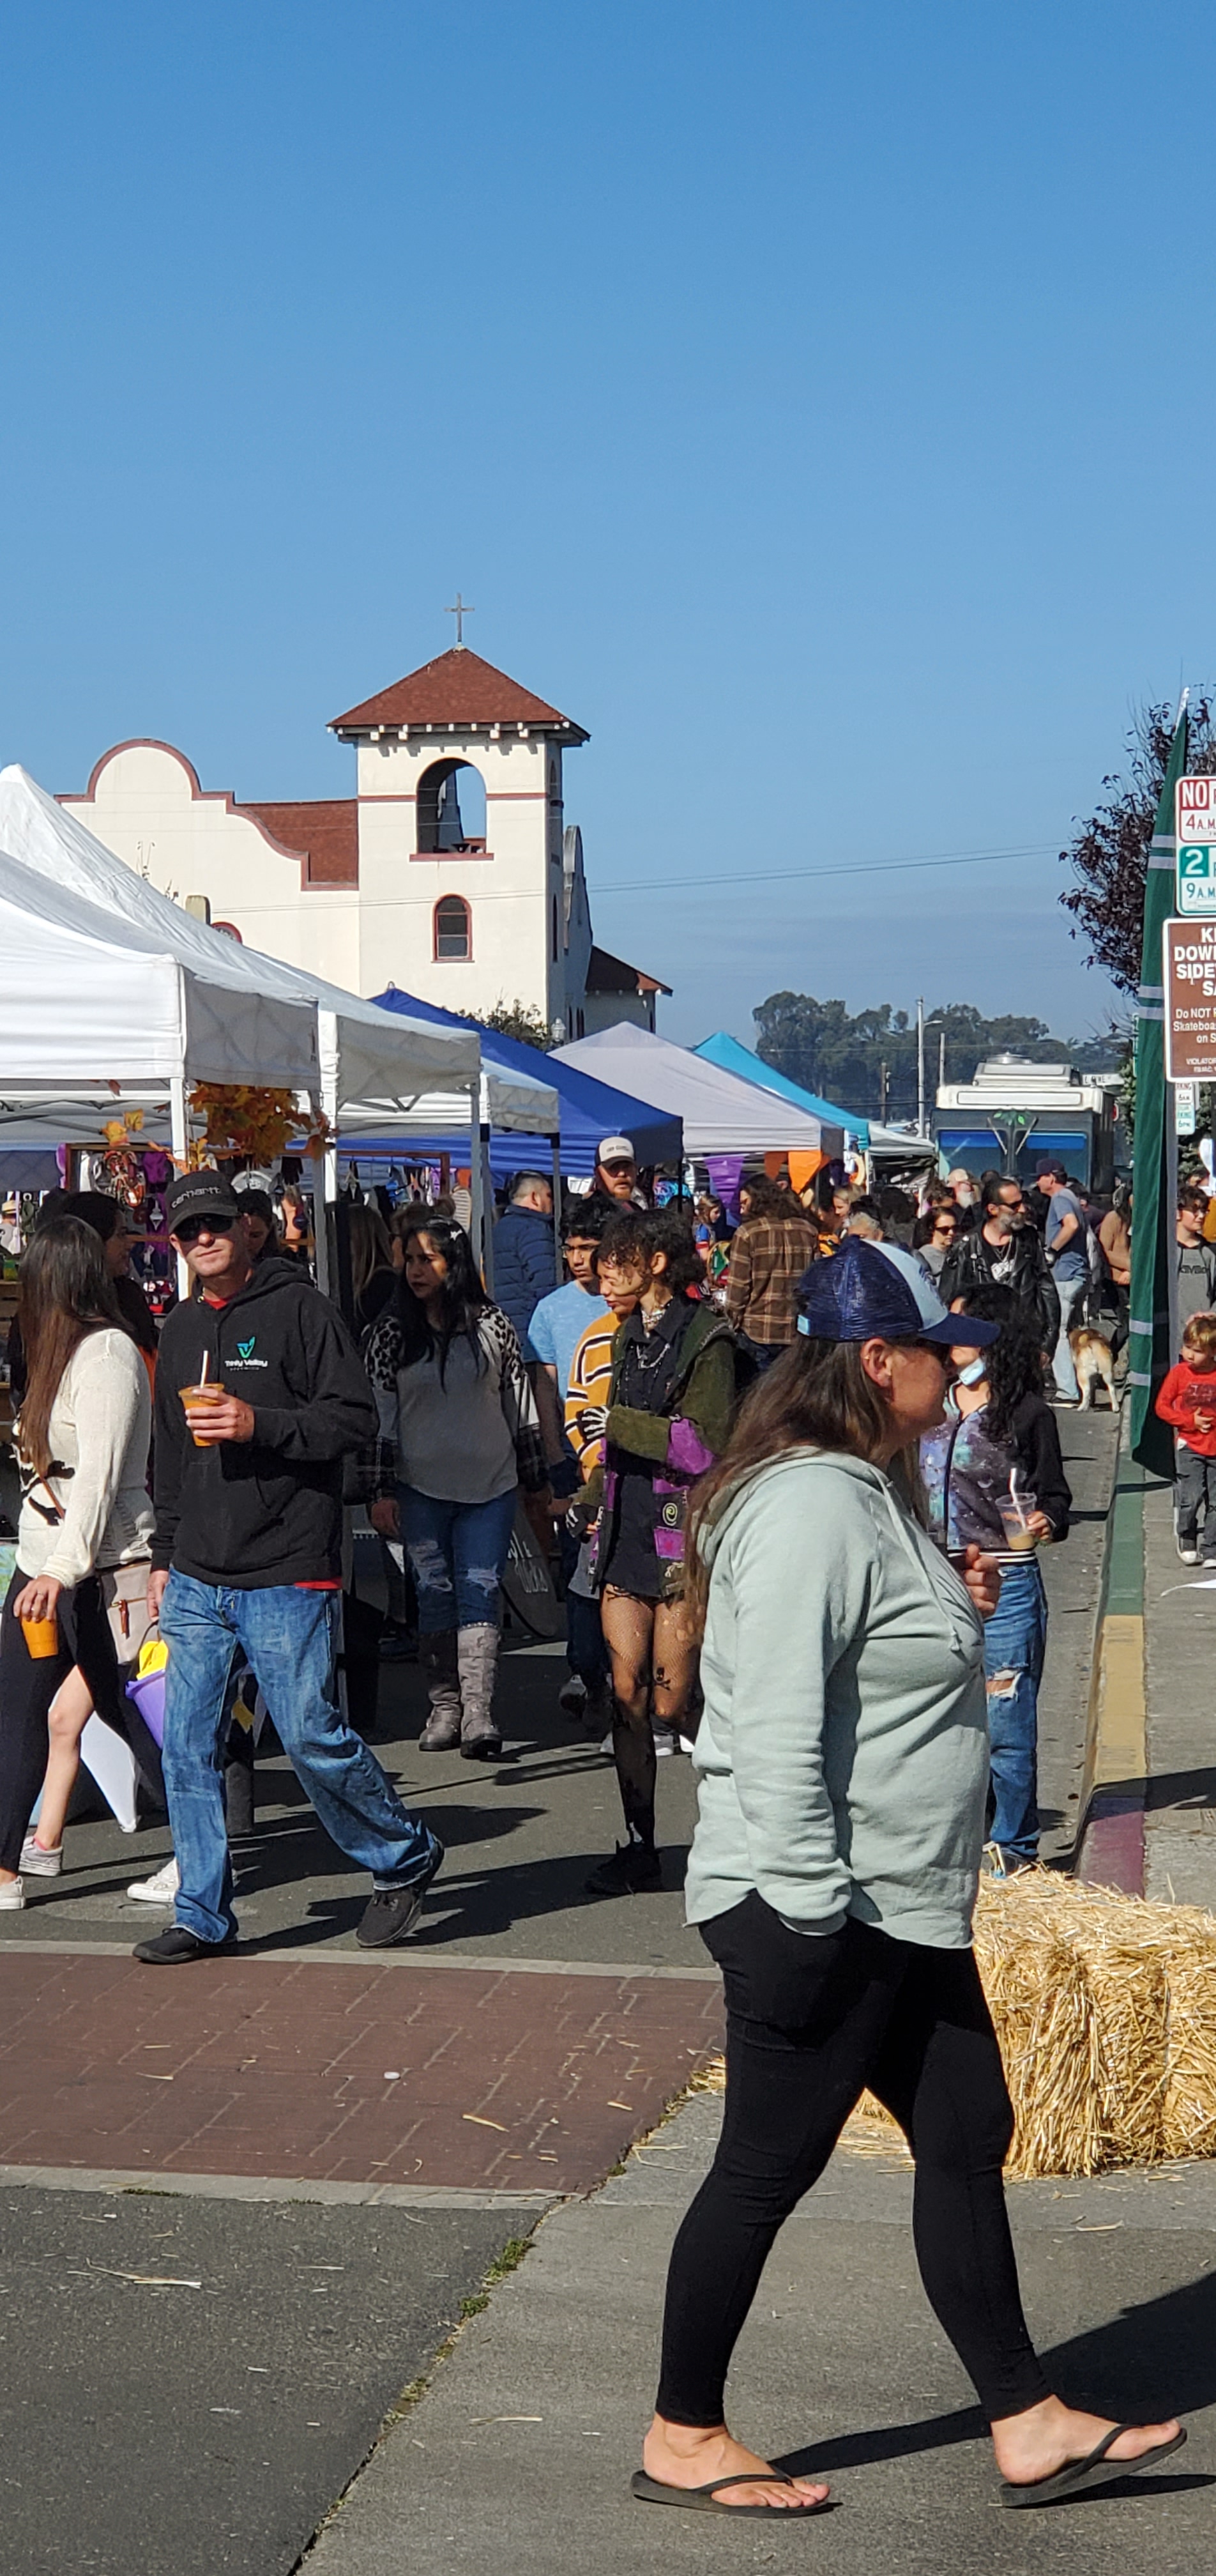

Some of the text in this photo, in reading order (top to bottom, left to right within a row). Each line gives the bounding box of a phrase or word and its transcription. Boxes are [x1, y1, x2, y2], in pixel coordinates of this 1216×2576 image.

[1183, 781, 1208, 808] NO
[1185, 849, 1204, 875] 2
[1176, 1009, 1189, 1018] Do
[1190, 1008, 1212, 1018] NOT
[1173, 1020, 1216, 1031] Skateboa
[171, 1186, 222, 1208] carhartt
